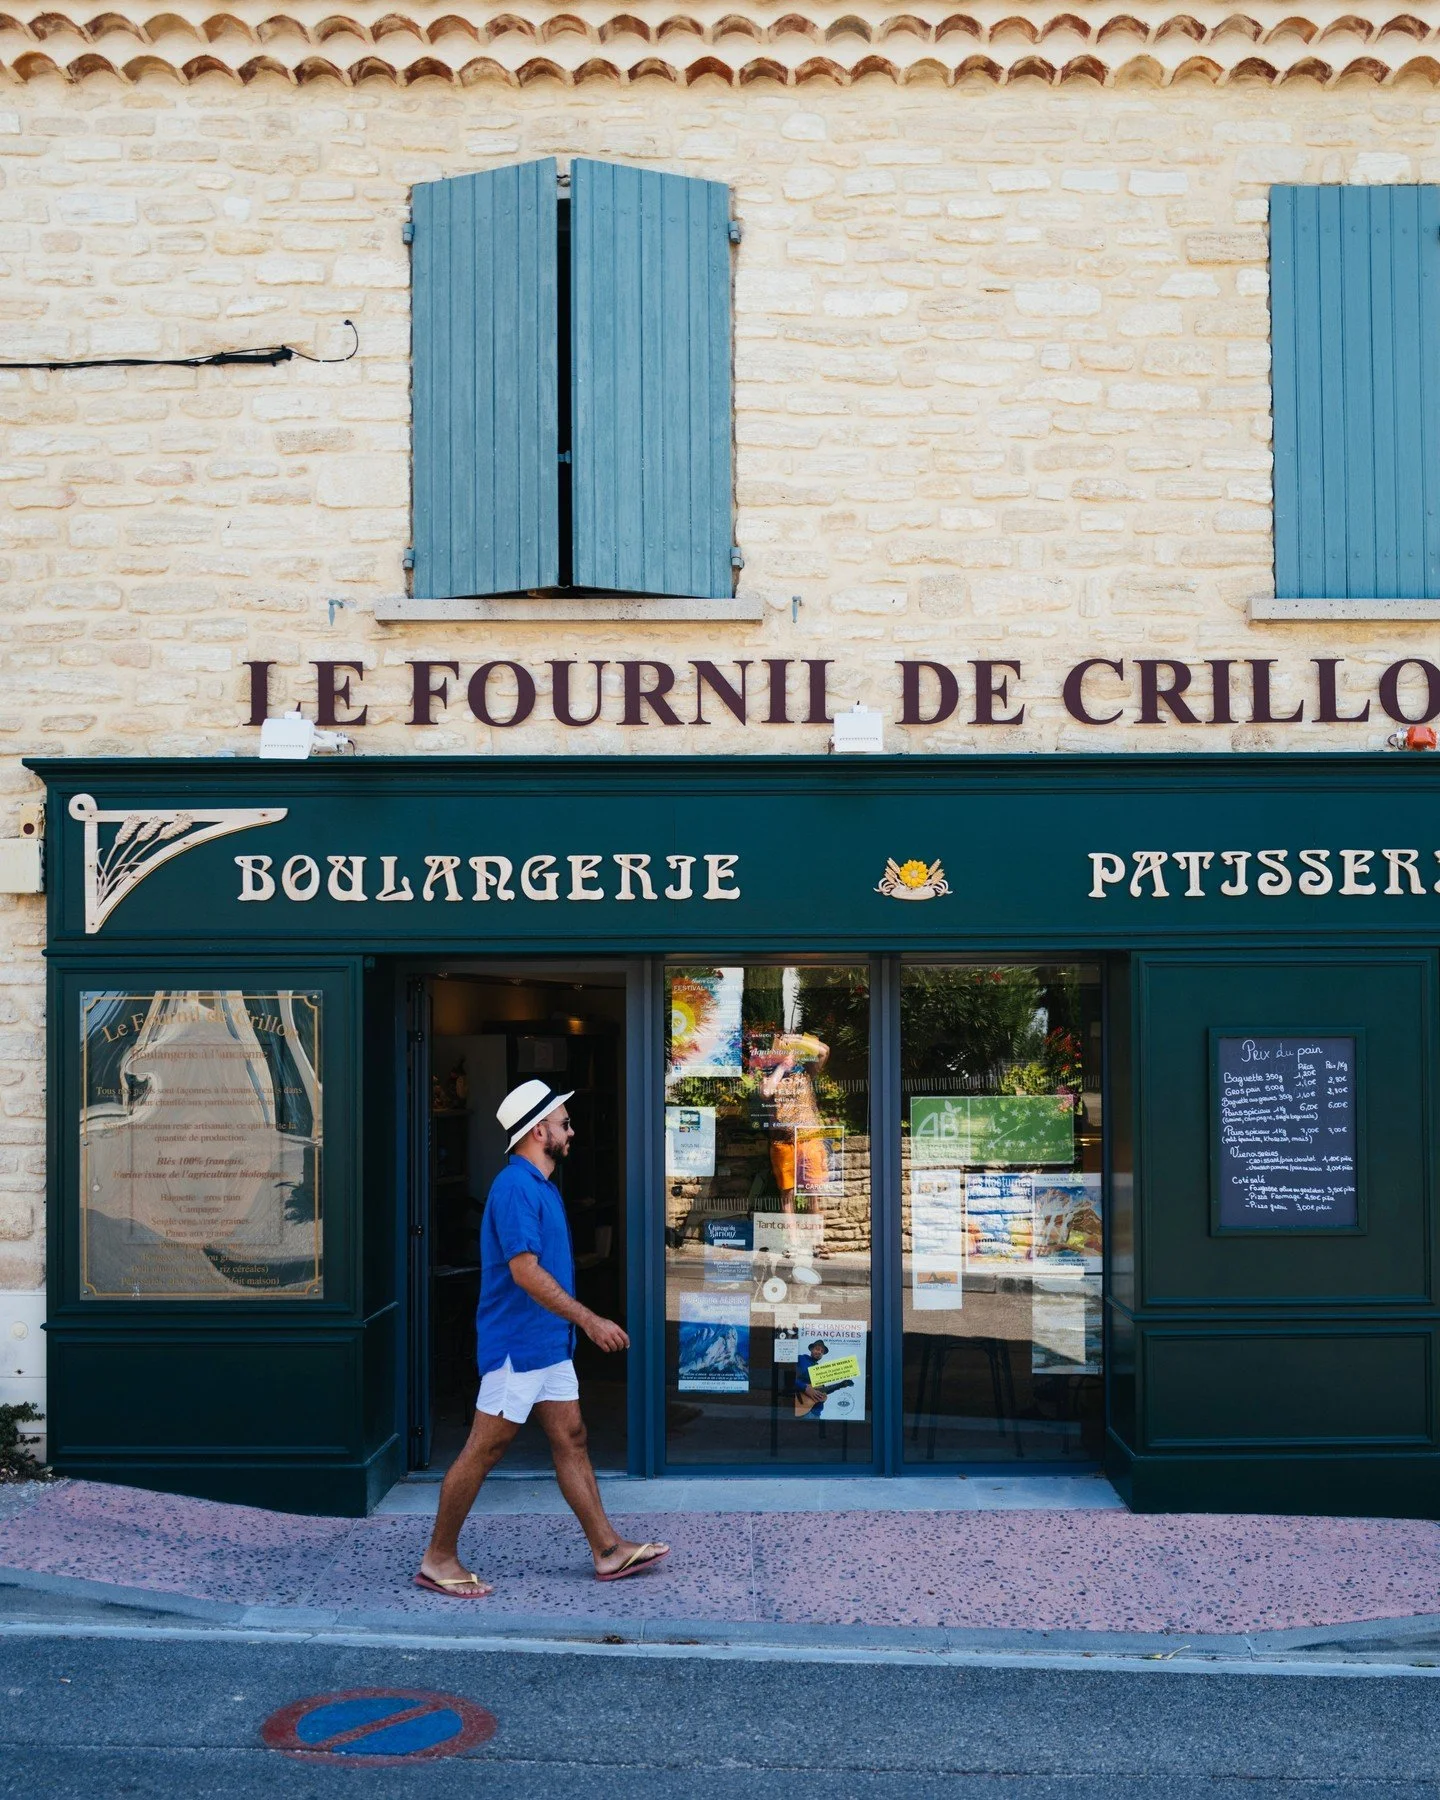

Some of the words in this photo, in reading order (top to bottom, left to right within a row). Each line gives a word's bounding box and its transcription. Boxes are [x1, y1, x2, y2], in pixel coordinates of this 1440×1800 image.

[403, 660, 836, 727] FOURNIL
[894, 659, 1026, 726] DE
[1062, 658, 1440, 726] CRILLO
[234, 853, 741, 902] BOULANGERIE
[1087, 848, 1440, 899] PATISSER
[101, 1022, 128, 1043] Le
[1275, 1042, 1294, 1059] du
[1297, 1044, 1323, 1063] pain
[1223, 1071, 1264, 1087] Baguette
[1265, 1073, 1283, 1083] 350g
[168, 1169, 180, 1179] de
[246, 1276, 280, 1286] maison)
[804, 1330, 862, 1339] FRANÇAISES
